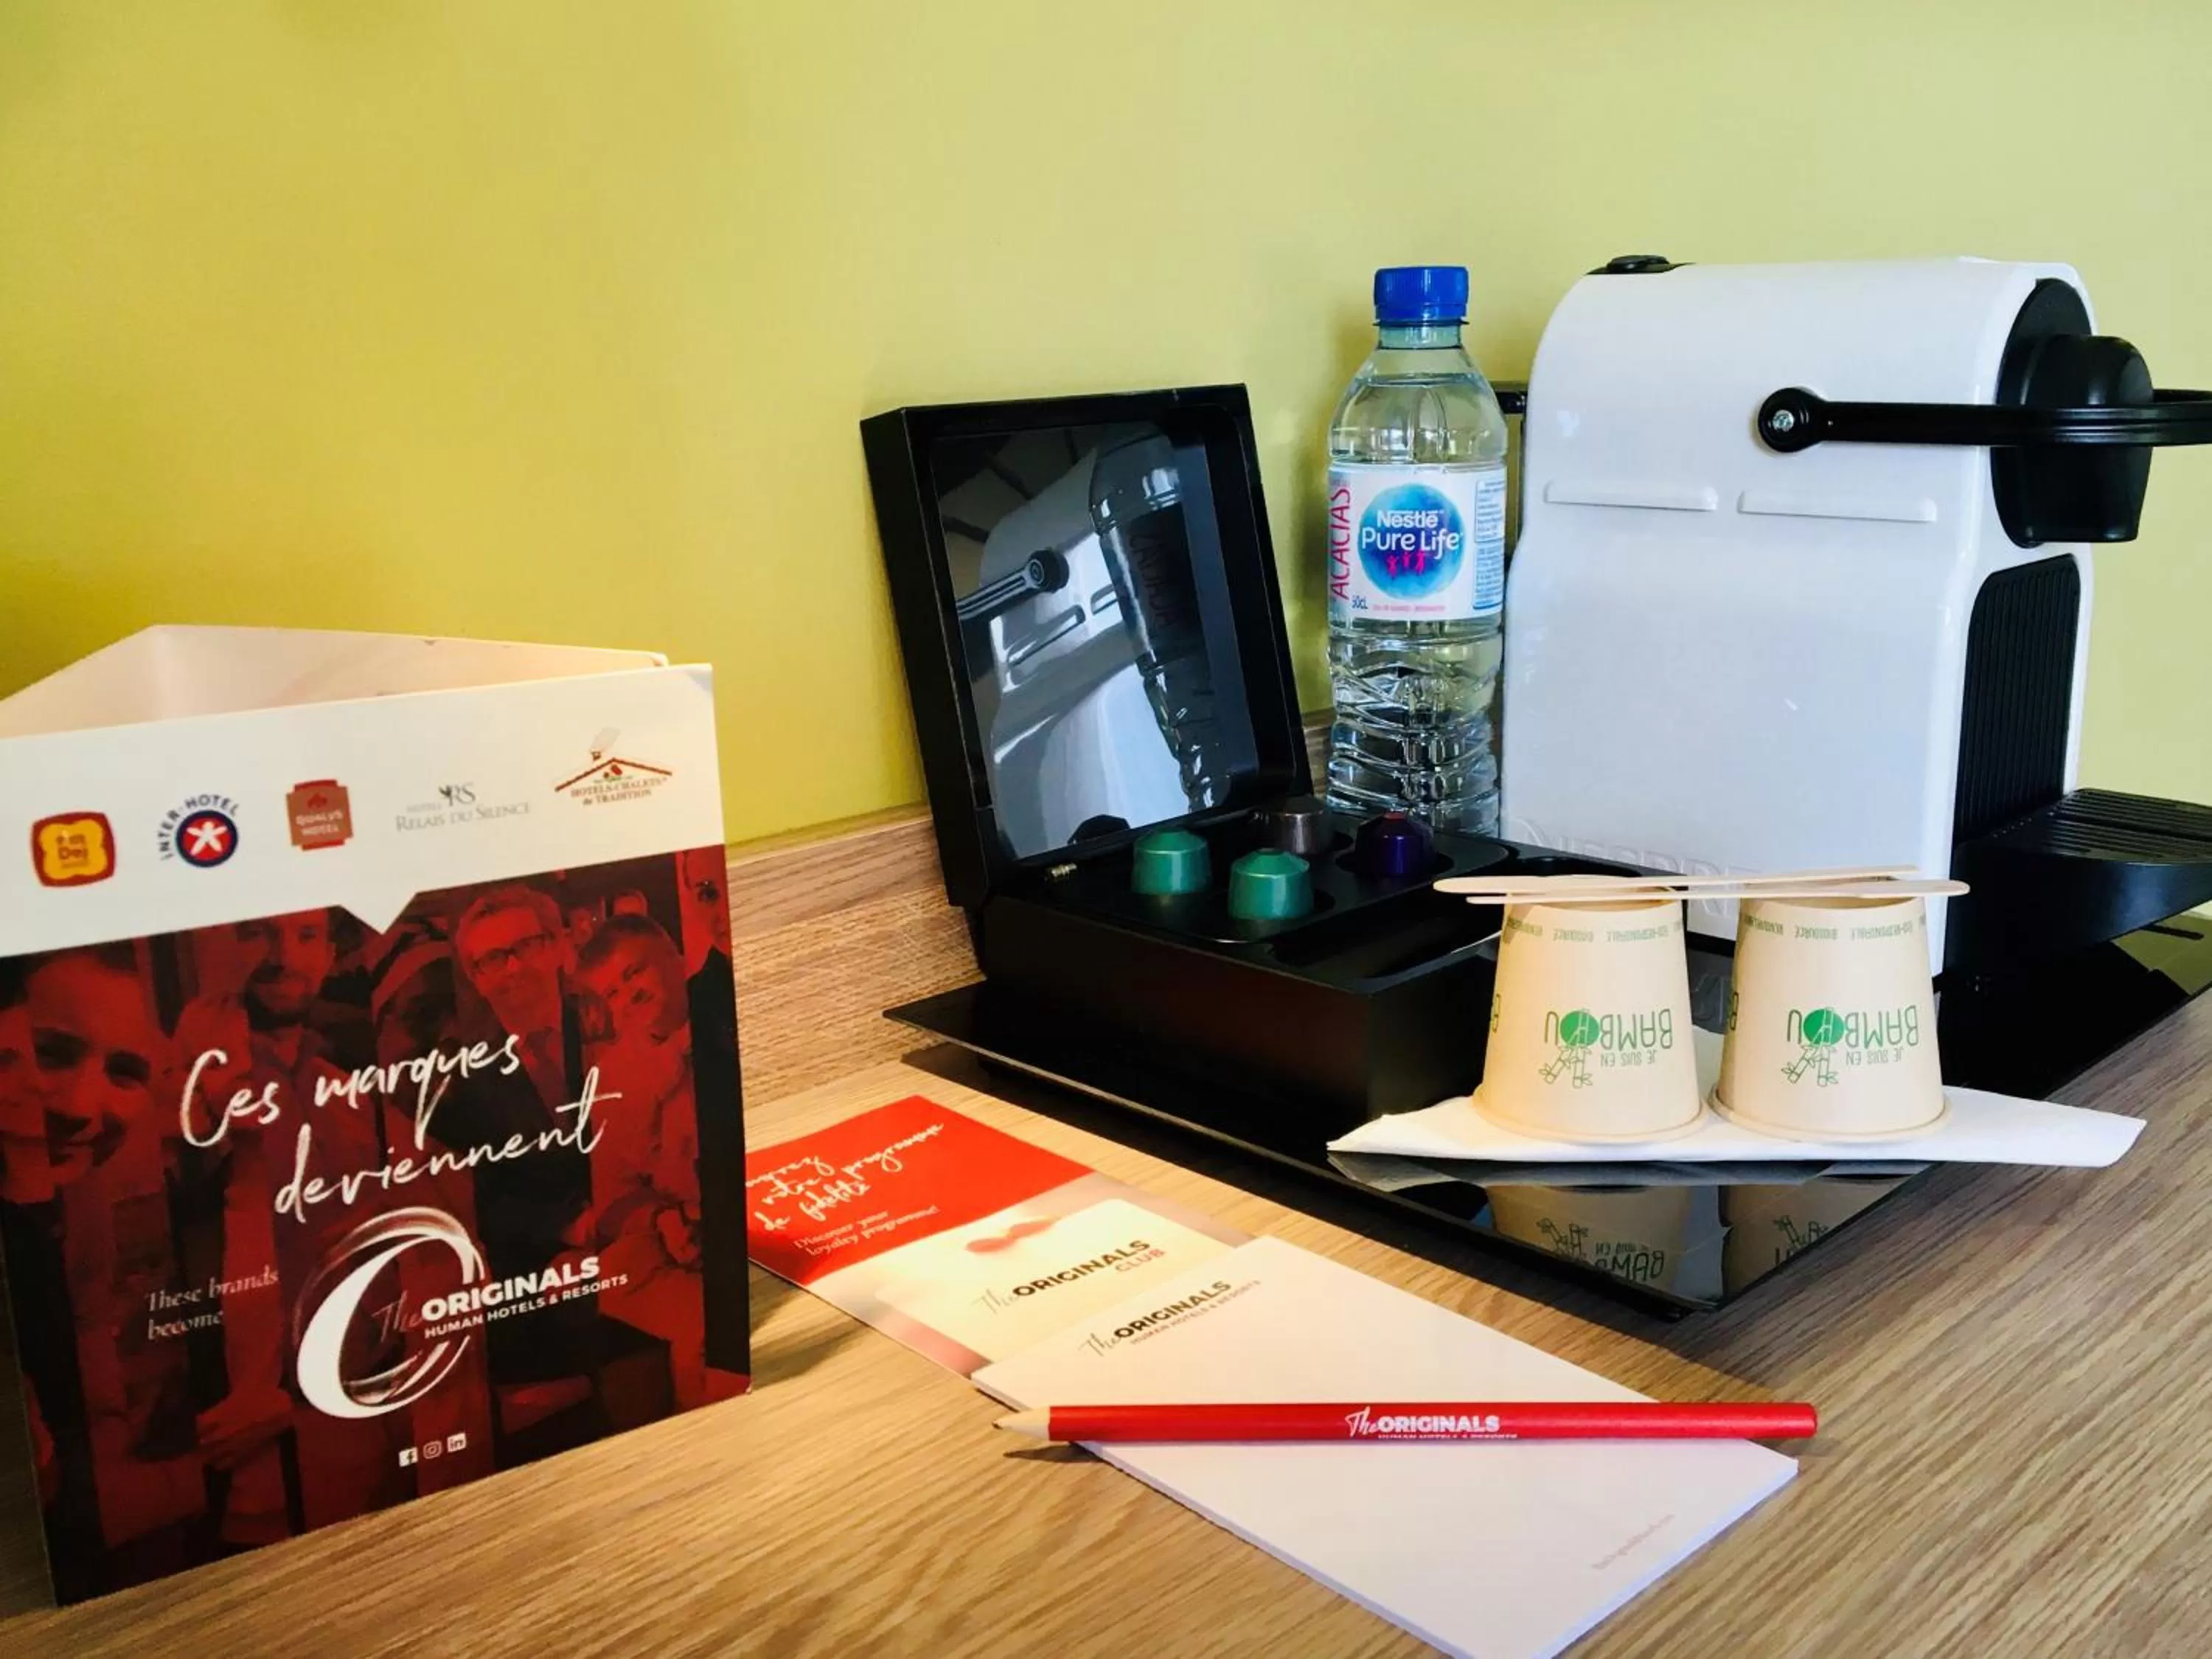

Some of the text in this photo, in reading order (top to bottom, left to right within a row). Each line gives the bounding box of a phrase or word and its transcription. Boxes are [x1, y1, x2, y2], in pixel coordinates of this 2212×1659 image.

[1330, 487, 1351, 601] ACACIAS
[1362, 527, 1460, 560] Pure Life
[1544, 1008, 1673, 1050] BAMBOU
[1787, 1005, 1919, 1050] BAMBOU
[1601, 1053, 1615, 1068] EN
[1846, 1051, 1862, 1066] EN
[181, 1034, 520, 1150] Ces marques
[275, 1067, 622, 1222] deviennent
[1012, 1240, 1150, 1296] ORIGINALS
[1115, 1248, 1165, 1273] CLUB
[145, 1264, 279, 1312] These brands
[421, 1256, 600, 1321] ORIGINALS
[425, 1315, 484, 1339] HUMAN
[487, 1297, 546, 1322] HOTELS
[562, 1274, 629, 1301] RESORTS
[1114, 1281, 1231, 1338] ORIGINALS
[148, 1310, 224, 1340] become
[1345, 1406, 1500, 1437] The ORIGINALS
